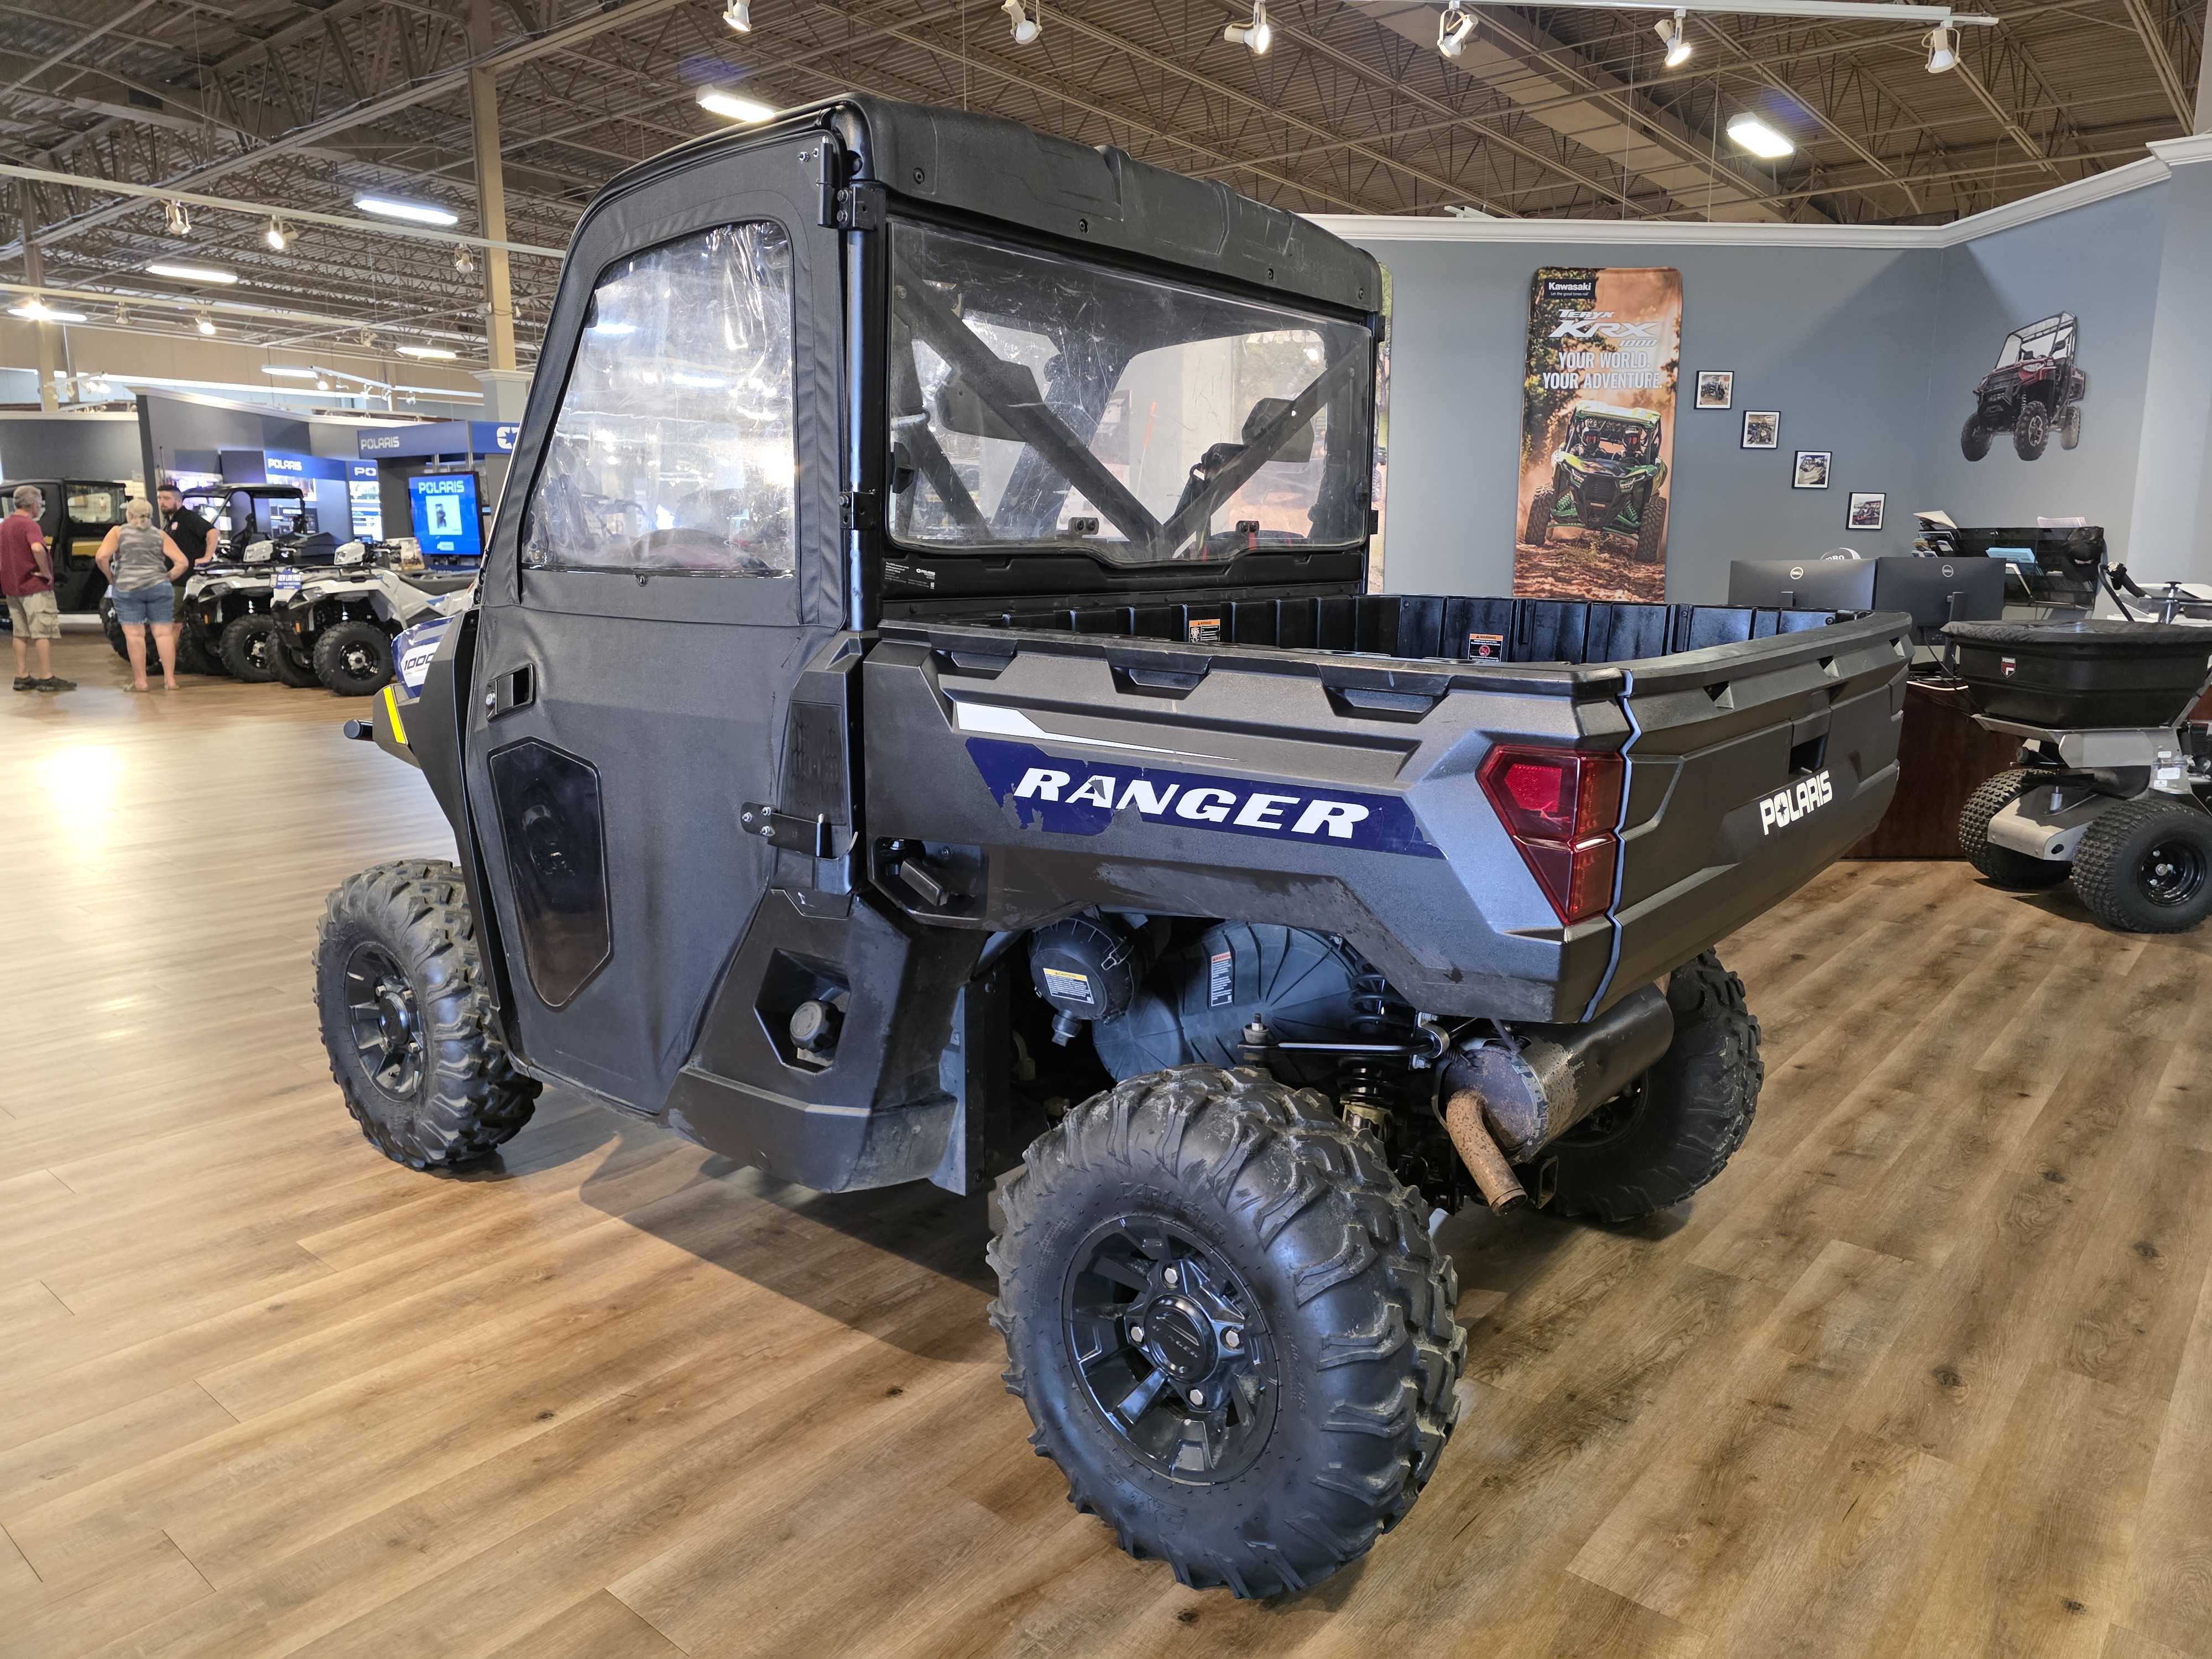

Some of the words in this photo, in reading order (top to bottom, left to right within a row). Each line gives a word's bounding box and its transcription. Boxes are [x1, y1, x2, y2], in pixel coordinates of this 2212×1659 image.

[1548, 282, 1592, 290] Kawasaki
[1548, 320, 1659, 338] KRX
[1558, 351, 1595, 369] YOUR
[1600, 352, 1650, 369] WORLD.
[1542, 372, 1579, 389] YOUR
[1583, 372, 1662, 389] ADVENTURE.
[361, 436, 400, 450] POLARIS
[268, 458, 302, 471] POLARIS
[419, 480, 465, 494] POLARIS
[1013, 767, 1369, 839] RANGER
[1759, 770, 1833, 836] POLARIS
